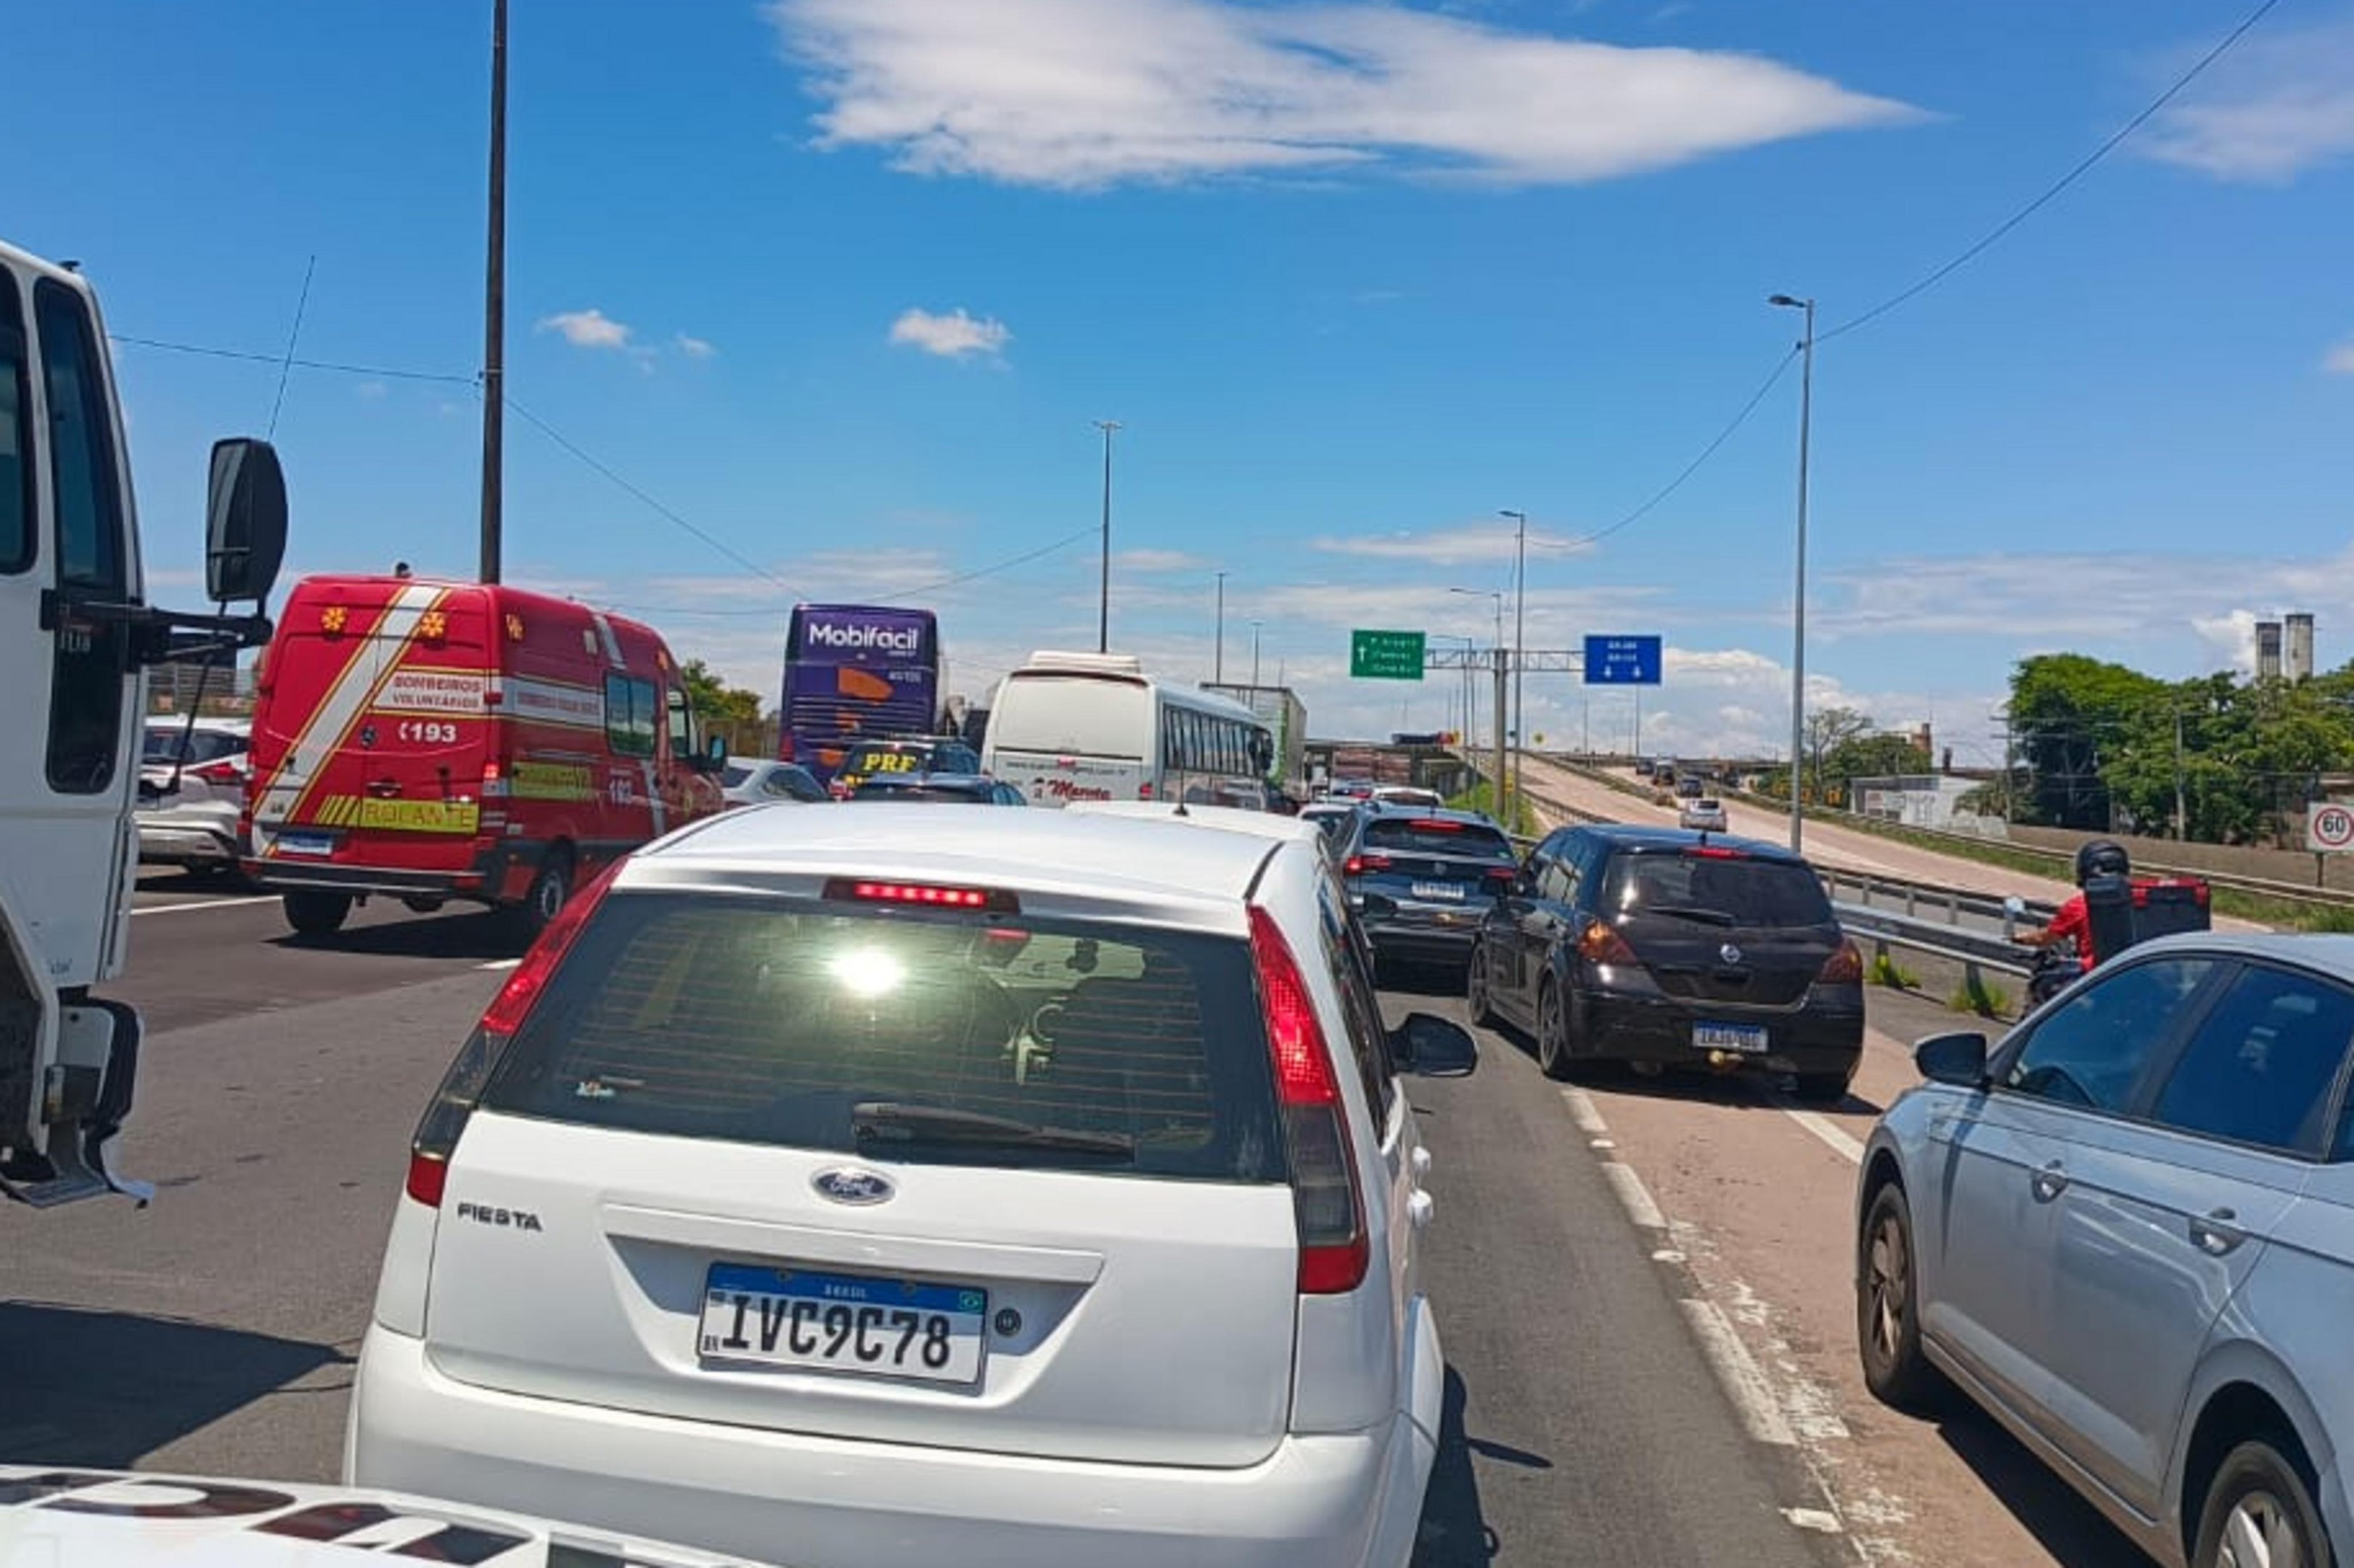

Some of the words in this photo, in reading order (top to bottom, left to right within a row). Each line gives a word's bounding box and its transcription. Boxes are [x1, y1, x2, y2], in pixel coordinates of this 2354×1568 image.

[393, 676, 483, 693] BOMBEIROS
[409, 722, 457, 743] 193
[863, 753, 918, 773] PRF
[364, 802, 474, 828] ROLANTE
[2322, 814, 2347, 833] 60
[457, 1201, 544, 1233] FIESTA
[722, 1294, 951, 1368] IVC9C78
